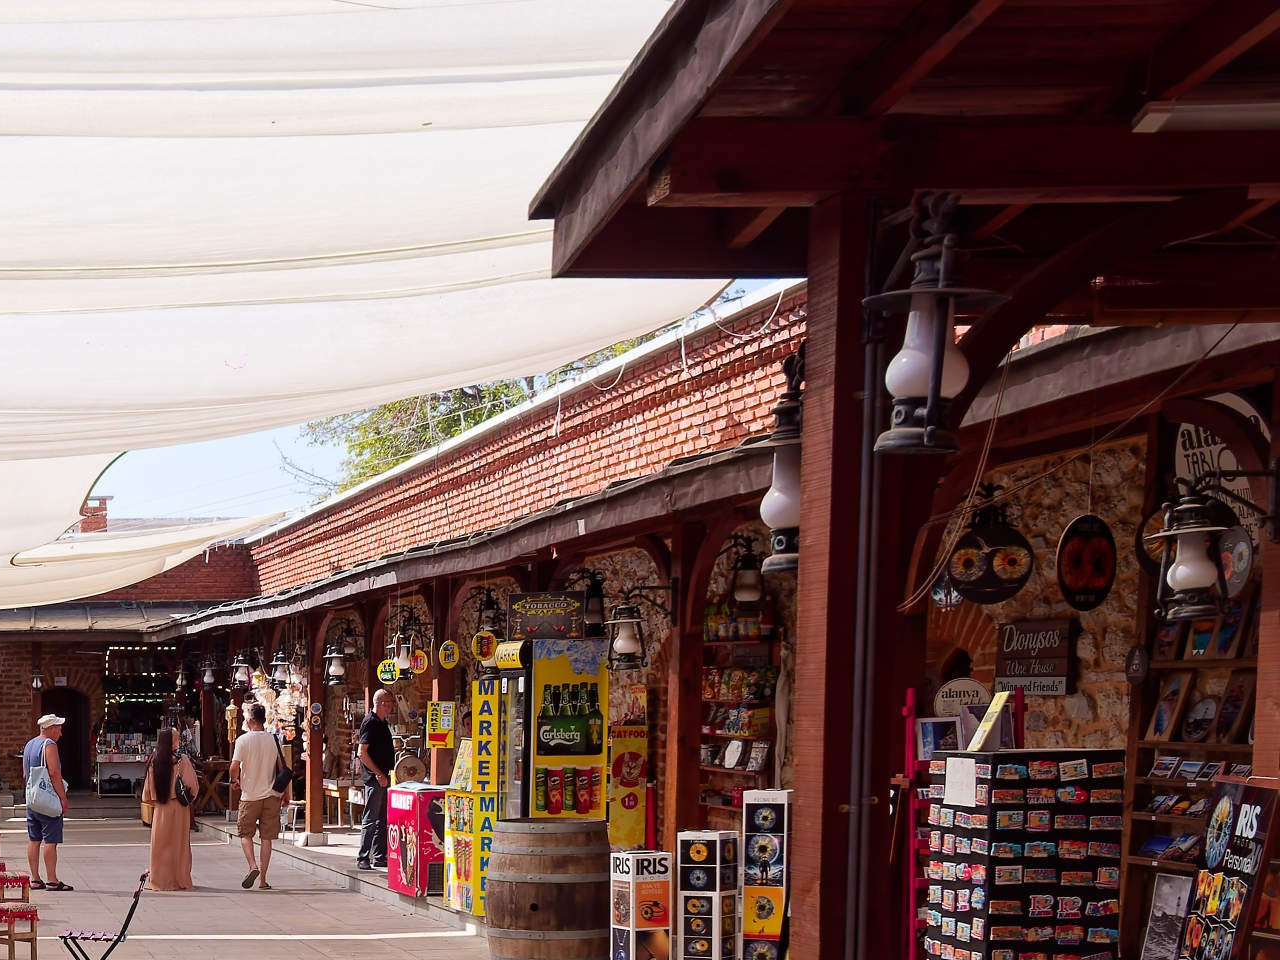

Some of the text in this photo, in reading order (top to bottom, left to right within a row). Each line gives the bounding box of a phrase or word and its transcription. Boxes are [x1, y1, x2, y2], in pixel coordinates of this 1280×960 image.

[1003, 624, 1060, 656] Dionysos
[1029, 659, 1056, 674] House
[430, 702, 440, 732] MARKET
[477, 680, 494, 791] MARKET
[540, 725, 581, 744] Carlsberg
[611, 730, 626, 738] CAT
[1234, 804, 1261, 840] IRIS
[612, 856, 631, 875] IRIS
[635, 857, 669, 876] IRIS
